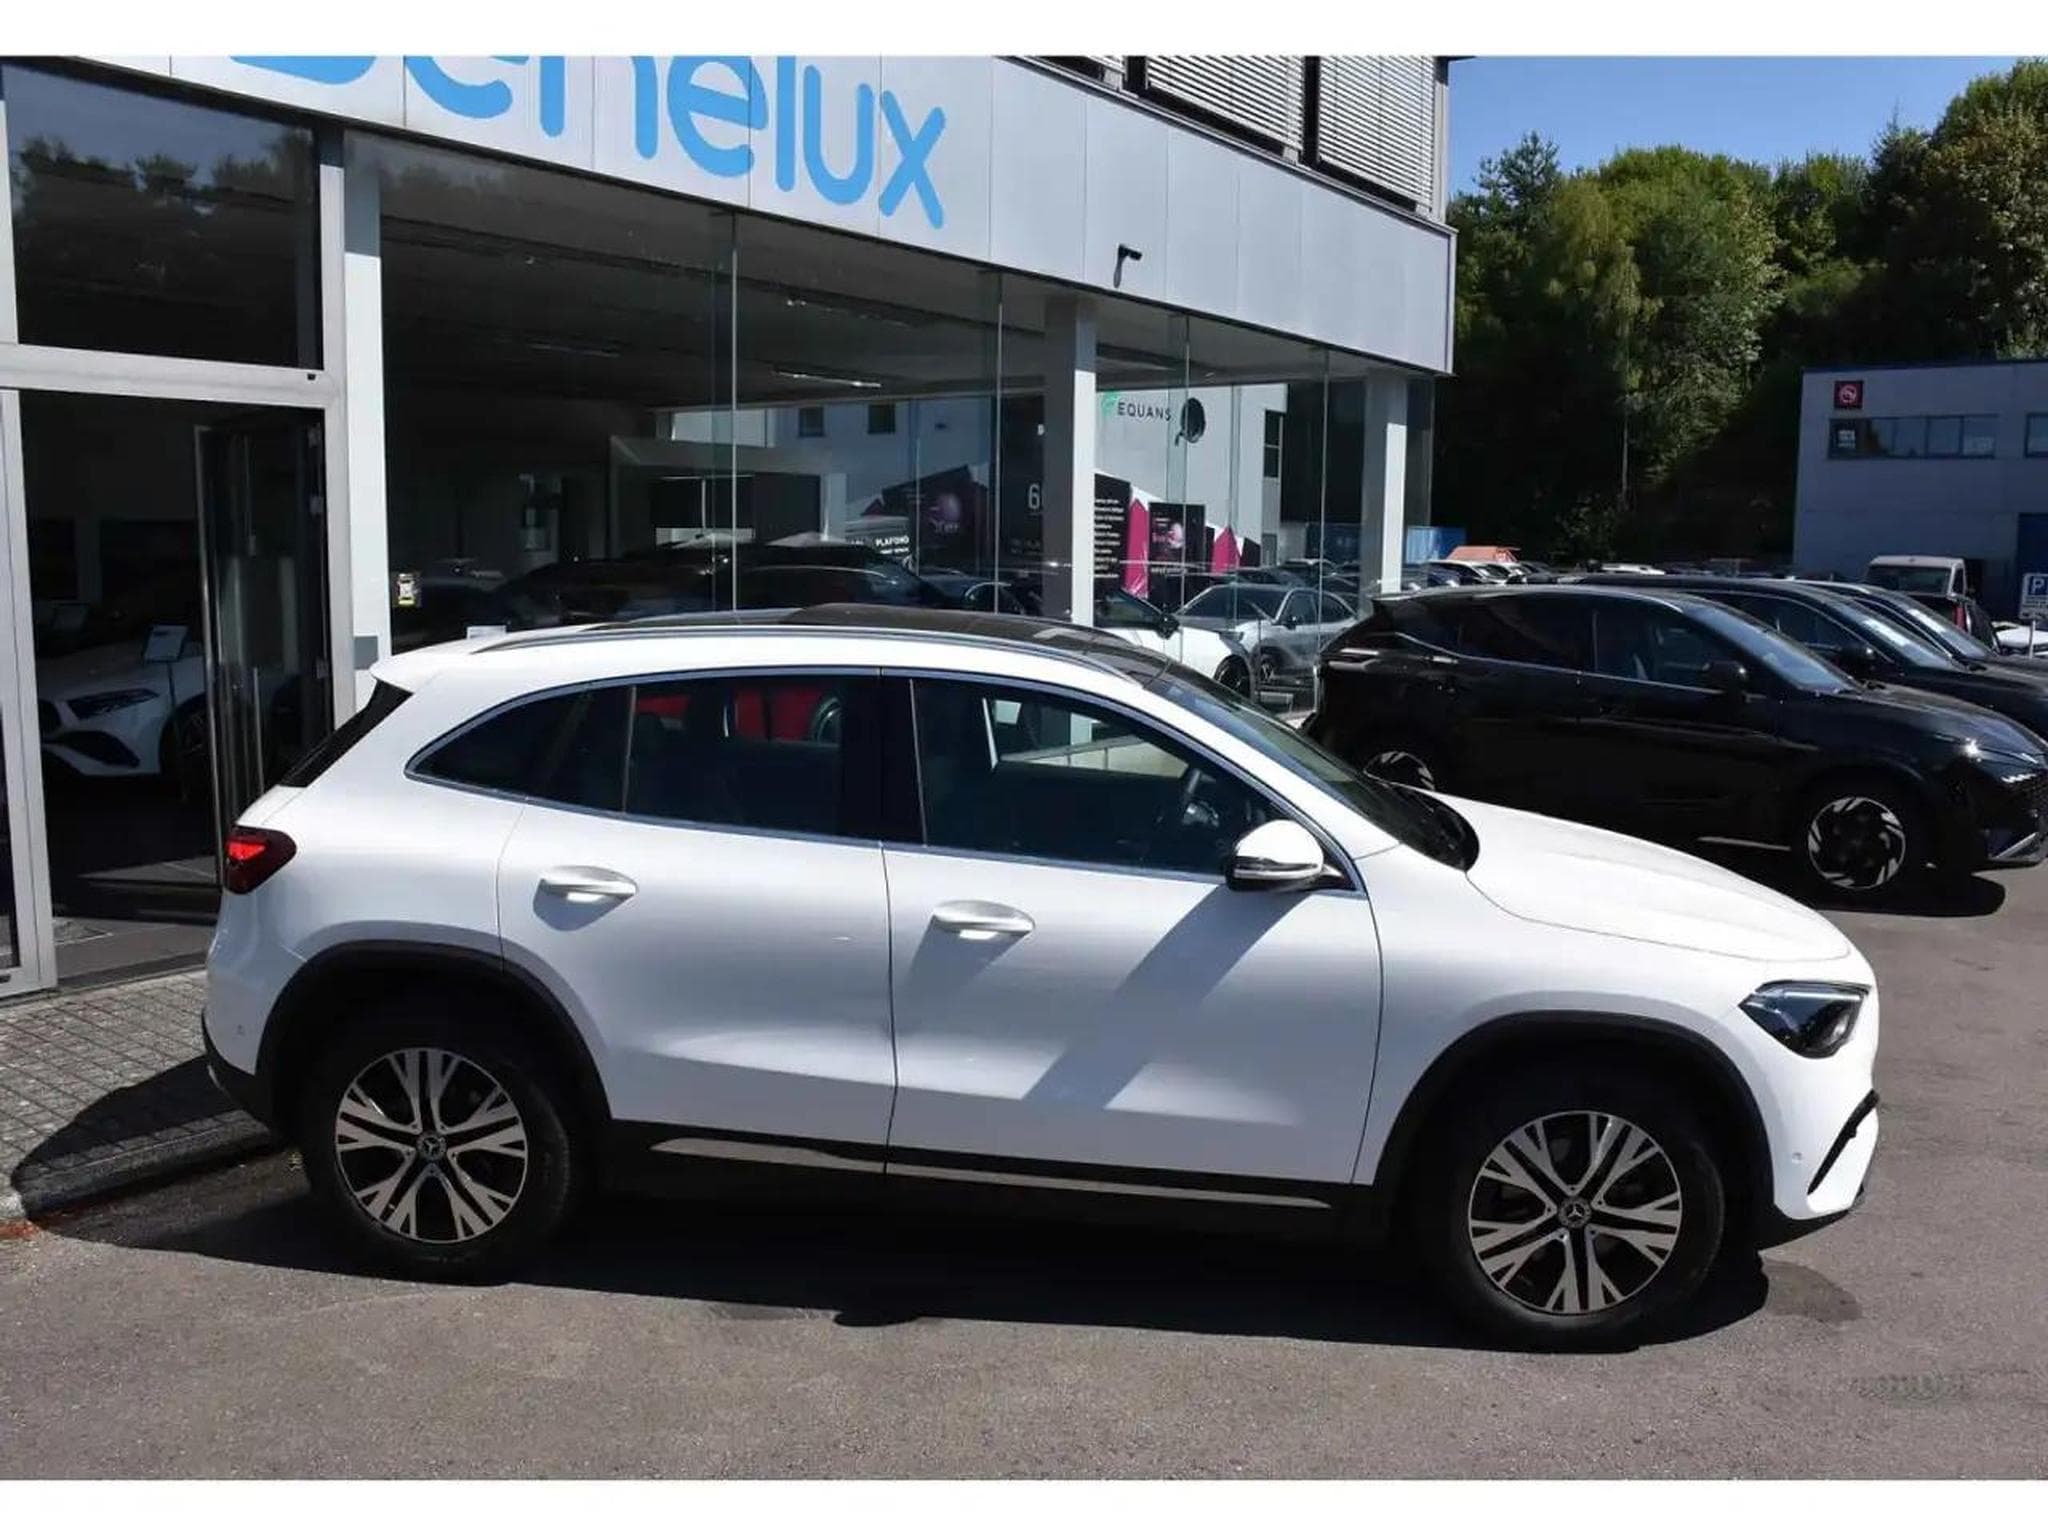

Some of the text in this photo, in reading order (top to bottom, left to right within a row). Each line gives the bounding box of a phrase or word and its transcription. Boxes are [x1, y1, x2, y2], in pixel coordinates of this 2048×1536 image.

[229, 56, 946, 229] nelux
[1117, 401, 1172, 421] EQUANS
[2031, 578, 2045, 594] P
